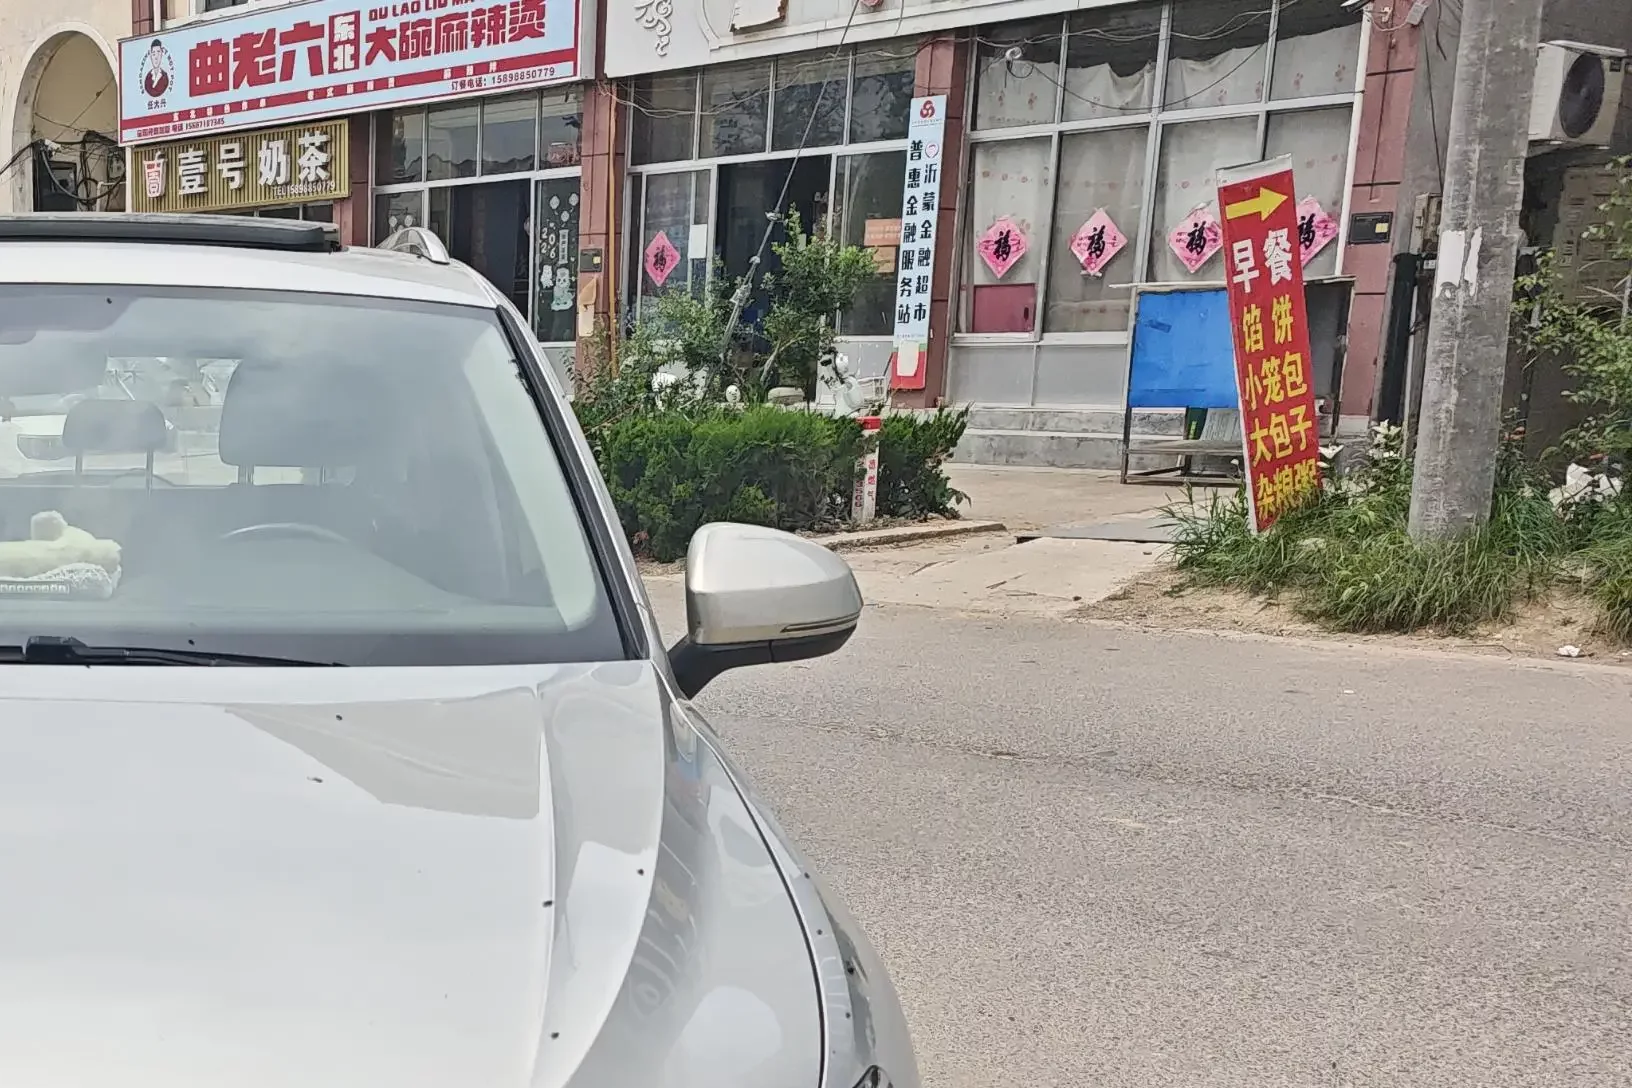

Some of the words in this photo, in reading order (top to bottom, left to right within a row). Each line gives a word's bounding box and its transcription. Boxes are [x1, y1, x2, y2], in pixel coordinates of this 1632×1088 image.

[189, 21, 325, 97] 曲老六
[333, 14, 357, 71] 东北
[365, 0, 546, 66] 大碗麻辣烫
[491, 66, 556, 85] 15898850779
[178, 129, 332, 196] 壹号奶茶
[897, 140, 924, 324] 普惠金融服务站
[913, 163, 938, 322] 沂蒙金融超市
[1232, 228, 1294, 294] 早餐
[1242, 294, 1294, 353] 馅饼
[1244, 351, 1308, 411] 小笼包
[1250, 404, 1313, 468] 大包子
[1257, 458, 1318, 521] 杂粮粥
